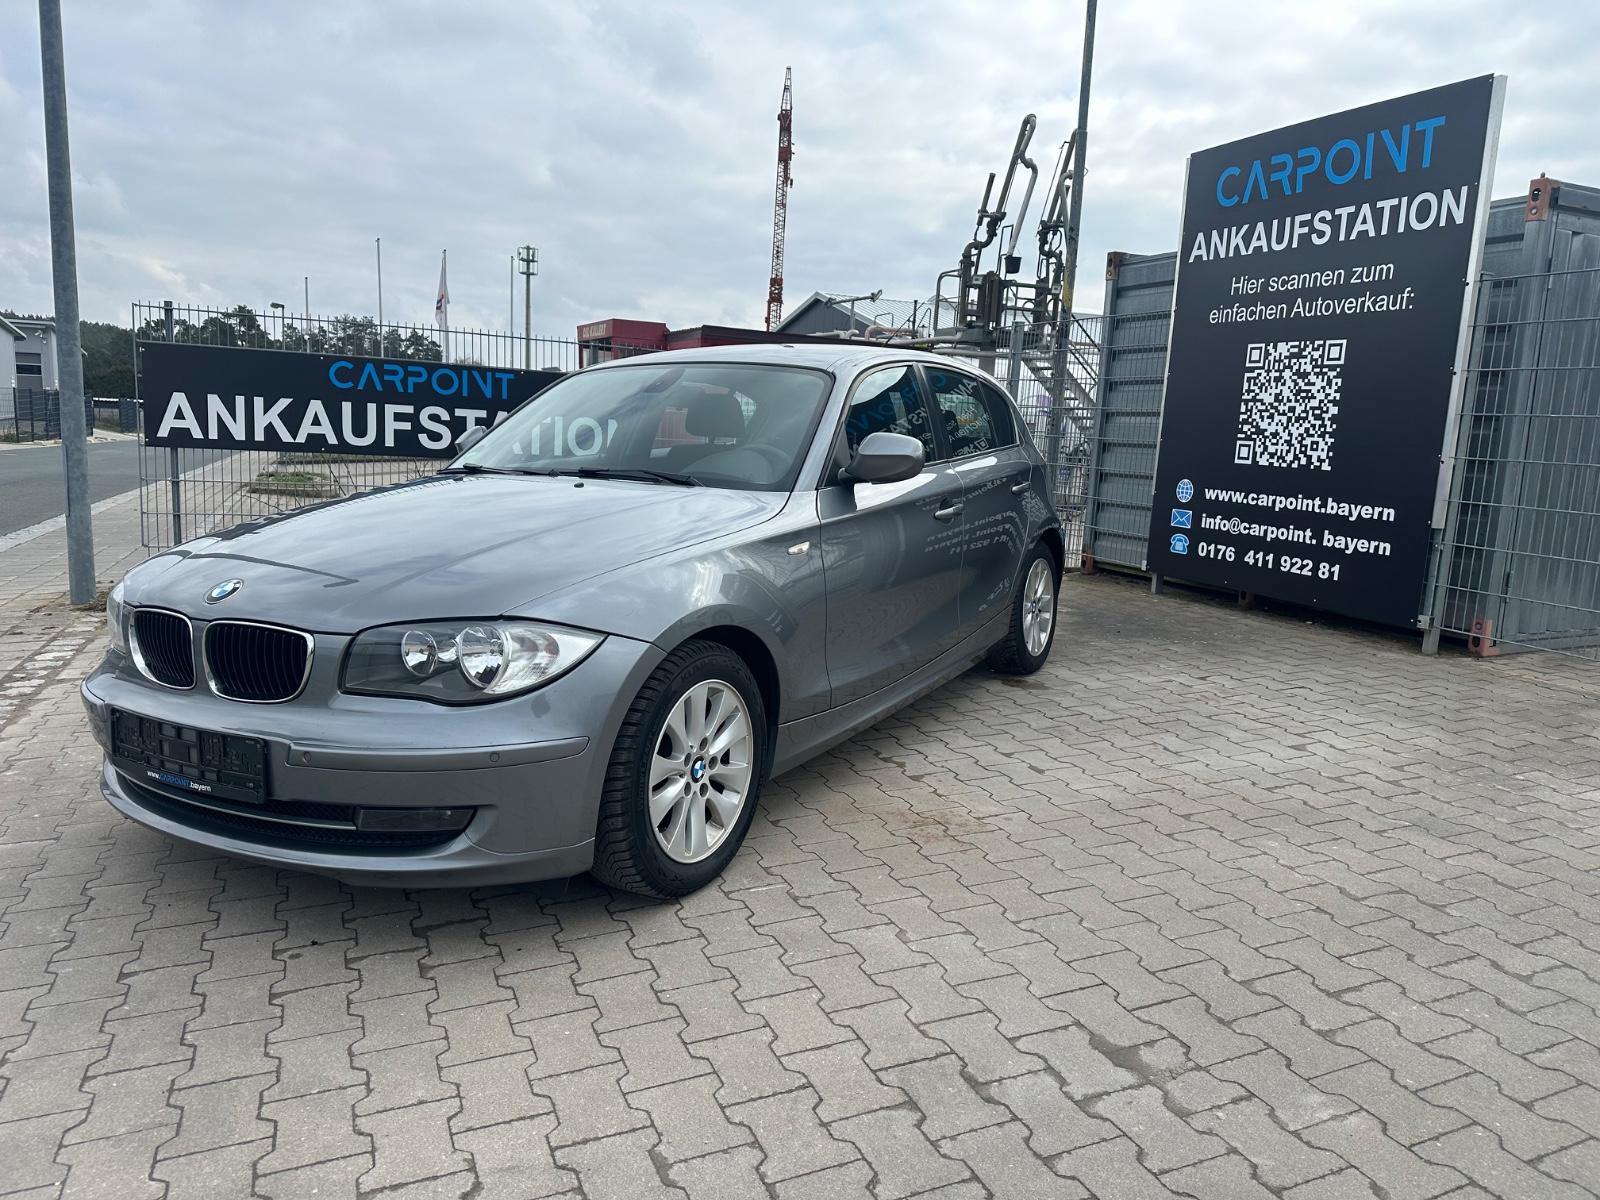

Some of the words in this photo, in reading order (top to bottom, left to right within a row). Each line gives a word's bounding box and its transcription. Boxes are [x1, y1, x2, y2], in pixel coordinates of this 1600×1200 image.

[1216, 115, 1446, 207] CARPOINT
[1189, 185, 1469, 263] ANKAUFSTATION
[1230, 275, 1265, 296] Hier
[1268, 268, 1345, 292] scannen
[1350, 263, 1394, 284] zum
[1209, 302, 1287, 324] einfachen
[1290, 287, 1415, 318] Autoverkauf:
[328, 360, 514, 400] CARPOINT
[1204, 488, 1395, 522] www.carpoint.bayern
[1201, 513, 1317, 545] info@carpoint.
[1323, 530, 1392, 556] bayern
[1198, 542, 1236, 562] 0176
[1244, 550, 1274, 568] 411
[1280, 556, 1313, 577] 922
[1318, 562, 1341, 581] 81
